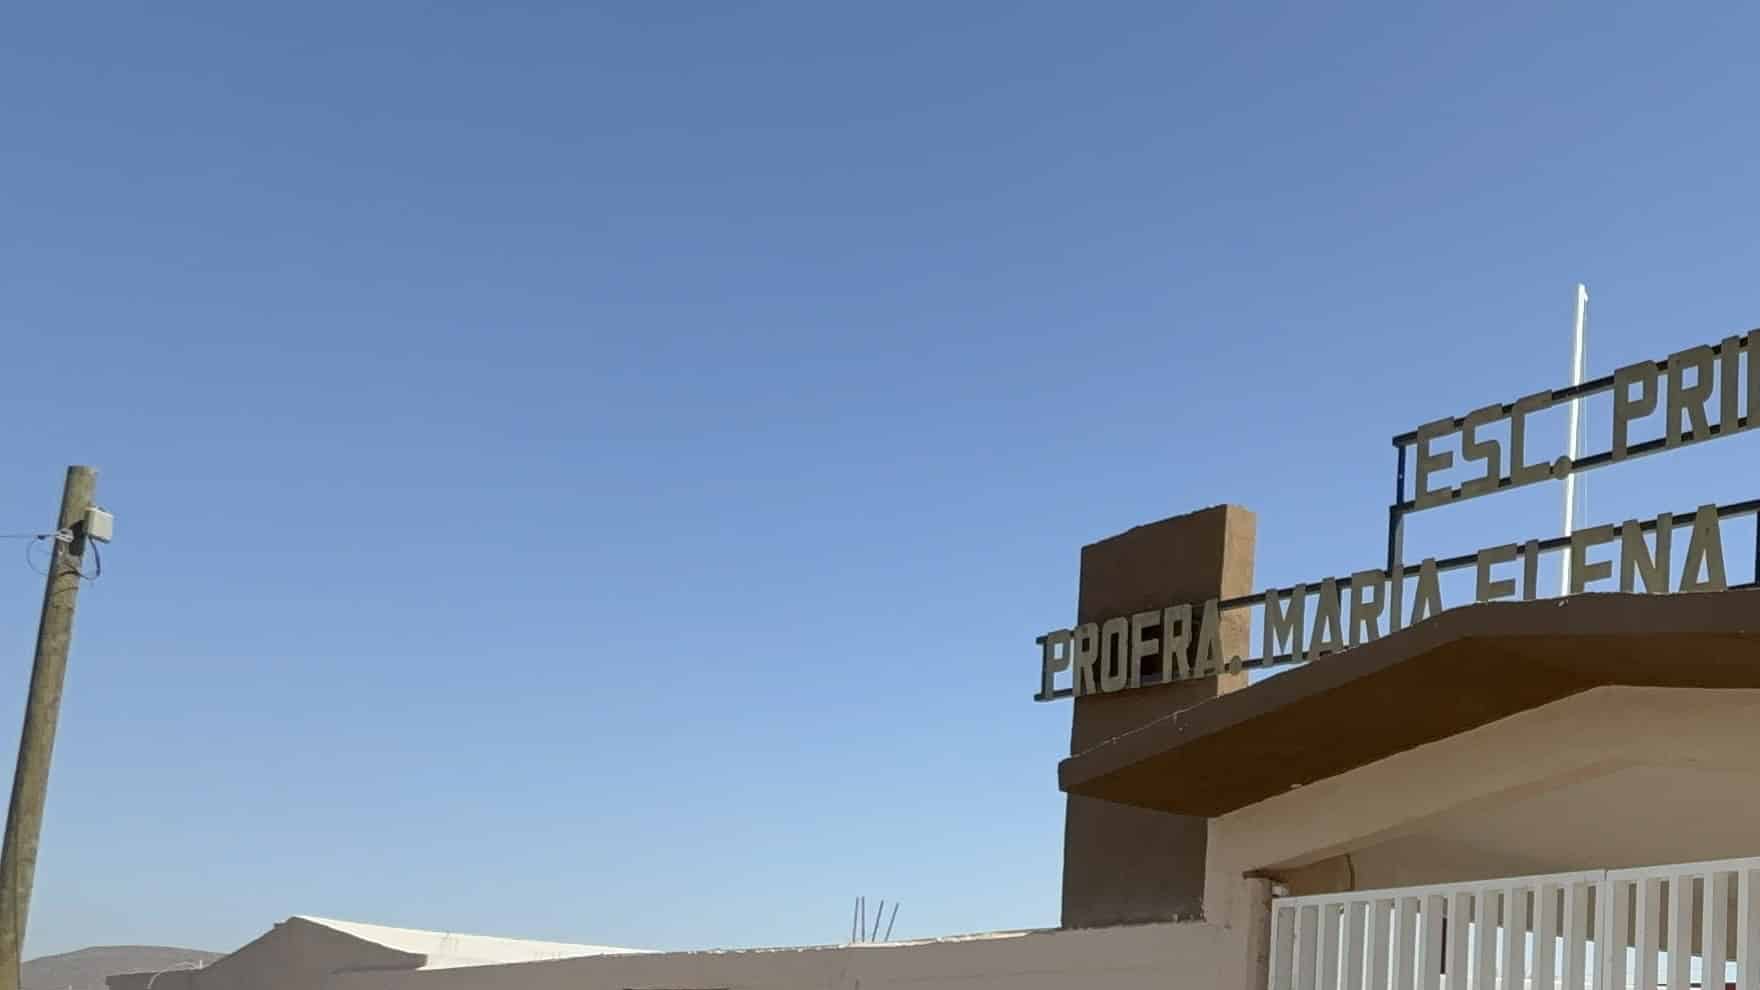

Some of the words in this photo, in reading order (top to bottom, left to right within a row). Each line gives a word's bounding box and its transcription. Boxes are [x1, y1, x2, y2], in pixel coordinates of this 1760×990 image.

[1415, 389, 1572, 509] ESC.
[1045, 598, 1243, 700] PROFRA.
[1264, 558, 1442, 666] MARIA
